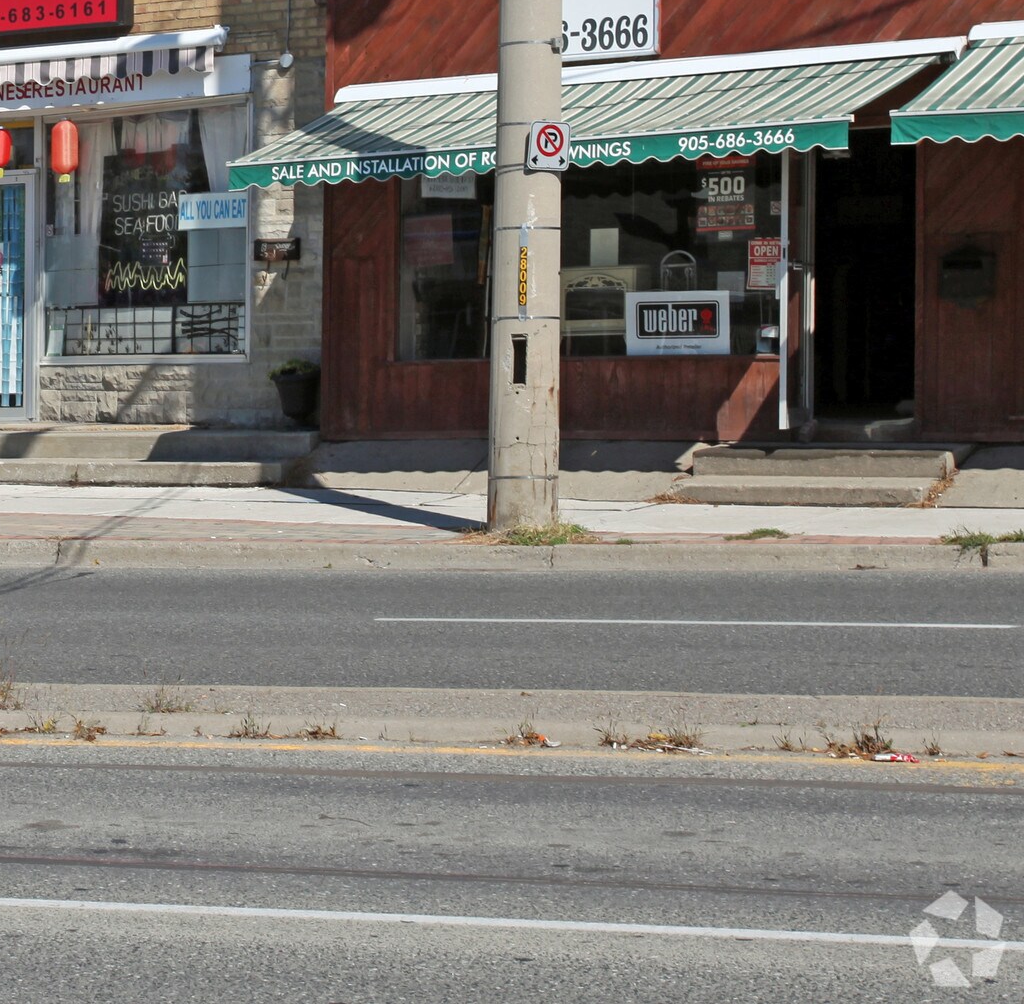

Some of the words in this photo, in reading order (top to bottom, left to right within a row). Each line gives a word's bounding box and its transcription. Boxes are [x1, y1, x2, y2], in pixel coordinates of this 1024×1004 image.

[677, 128, 795, 152] 905-686-3666
[271, 165, 304, 181] SALE
[307, 161, 342, 178] AND
[346, 154, 451, 176] INSTALLATION
[454, 152, 477, 168] OF
[701, 176, 745, 196] $500
[113, 193, 155, 213] SUSHI
[180, 201, 194, 221] ALL
[195, 200, 212, 220] YOU
[214, 199, 230, 219] CAN
[232, 198, 247, 219] EAT
[754, 245, 779, 256] OPEN
[519, 246, 529, 306] 28009
[643, 303, 698, 333] weber
